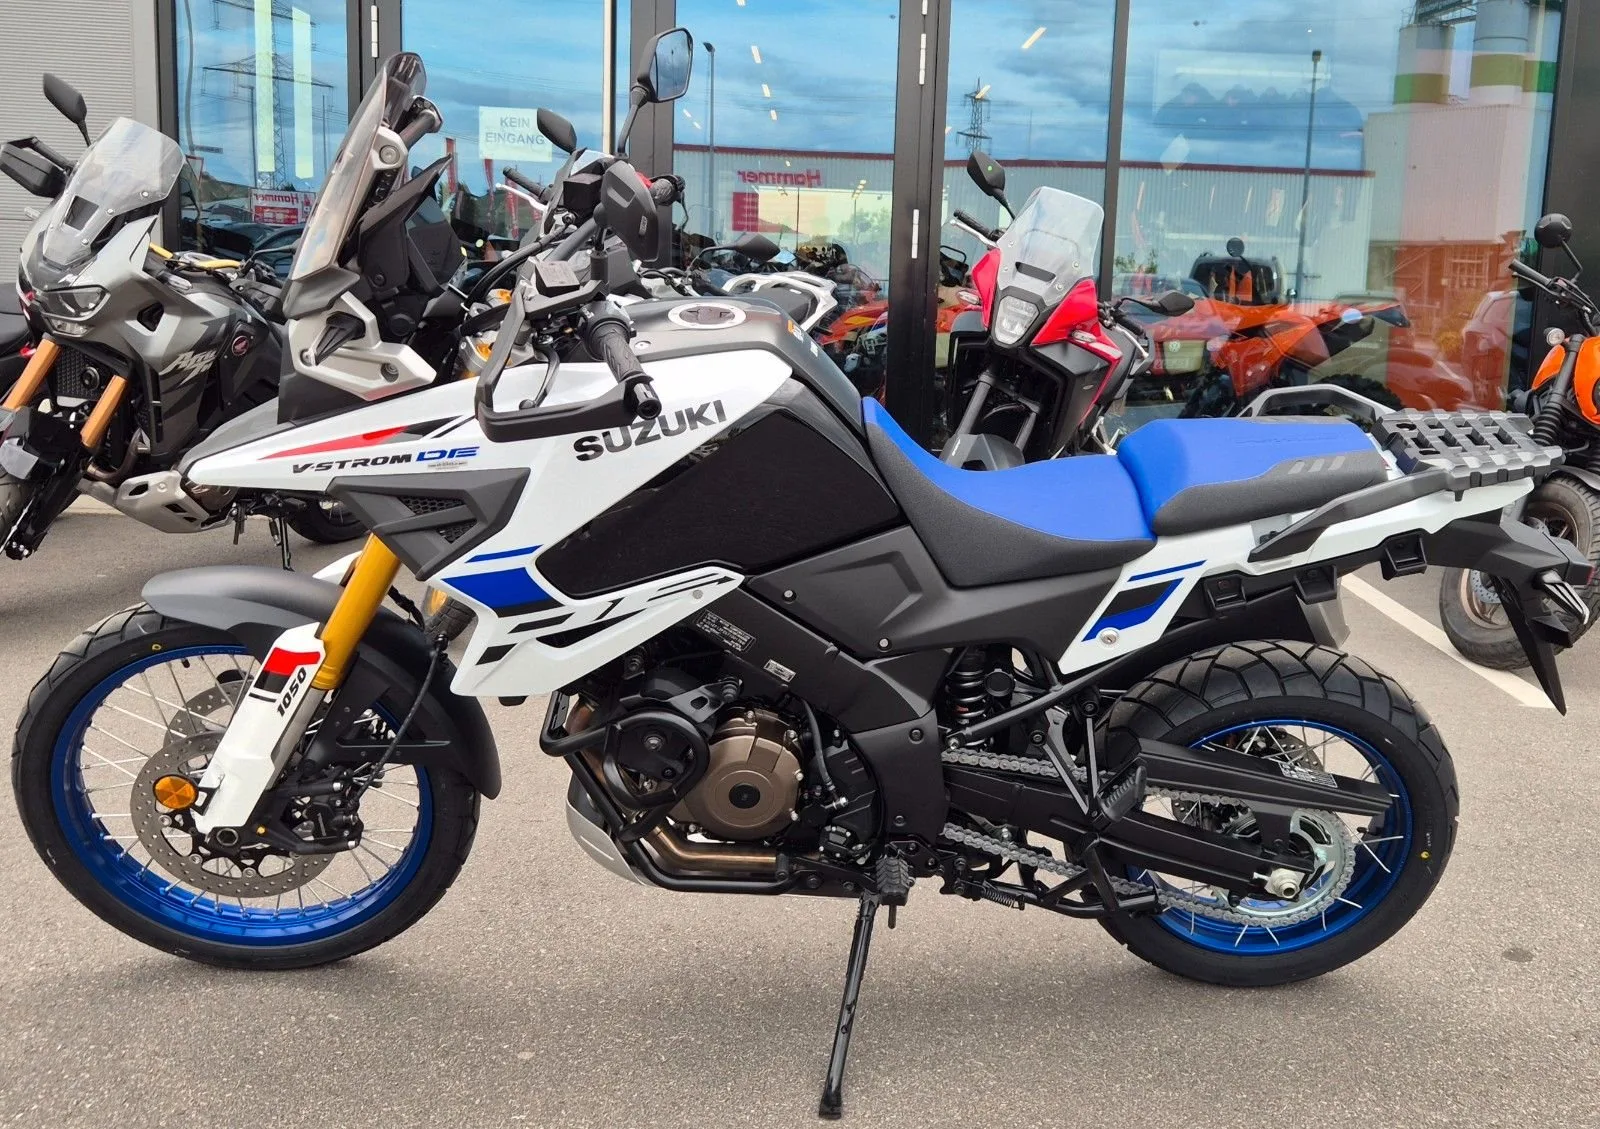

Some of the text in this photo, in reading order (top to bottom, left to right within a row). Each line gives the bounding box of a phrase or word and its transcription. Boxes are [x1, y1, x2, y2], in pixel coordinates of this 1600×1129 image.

[500, 117, 530, 128] KEIN
[485, 132, 545, 145] EINGANG
[573, 399, 727, 462] SUZUKI
[416, 446, 480, 462] DE
[277, 666, 307, 717] 1050
